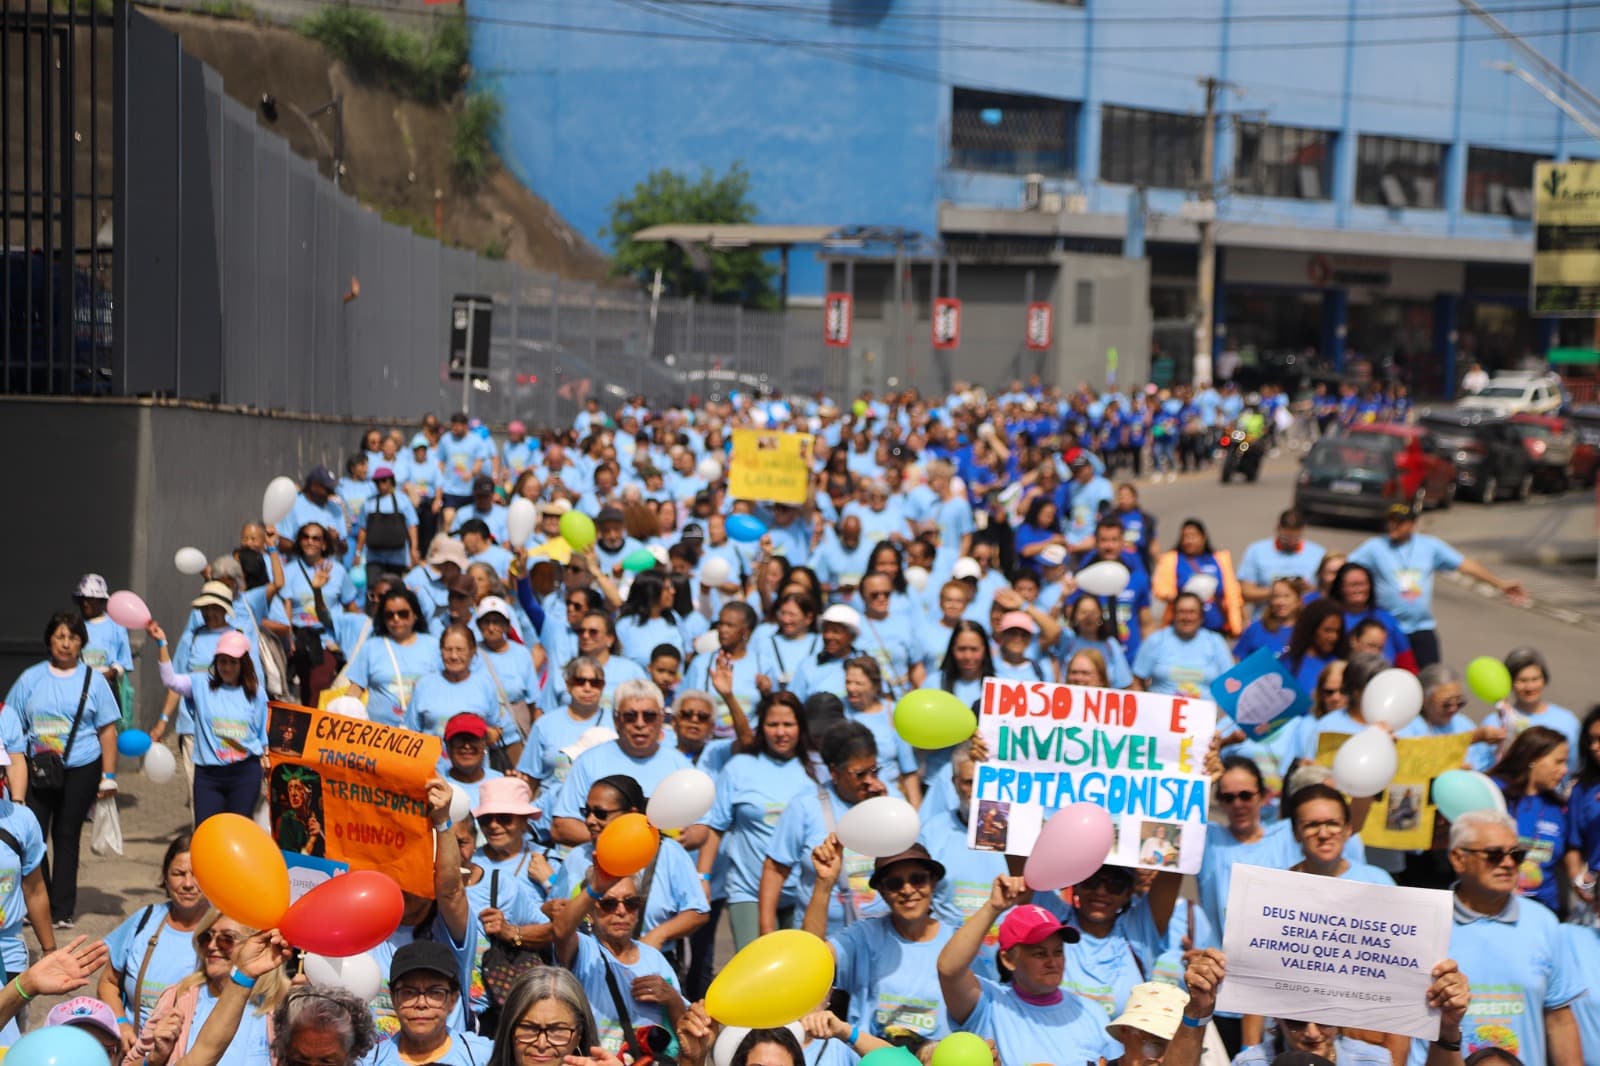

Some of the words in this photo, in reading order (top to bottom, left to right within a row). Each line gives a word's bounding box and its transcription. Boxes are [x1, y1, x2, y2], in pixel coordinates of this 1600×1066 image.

[984, 682, 1072, 720] IDOSO
[316, 716, 423, 758] EXPERIÊNCIA
[997, 725, 1164, 771] INVISIVEL
[319, 748, 377, 775] TAMBÉM
[976, 765, 1207, 824] PROTAGONISTA
[347, 822, 405, 850] MUNDO
[1263, 905, 1296, 920] DEUS
[1300, 911, 1347, 928] NUNCA
[1350, 918, 1387, 933] DISSE
[1390, 923, 1417, 937] QUE
[1281, 925, 1318, 940] SERIA
[1322, 928, 1357, 945] FÁCIL
[1361, 936, 1391, 949] MAS
[1249, 937, 1310, 955] AFIRMOU
[1313, 945, 1340, 959] QUE
[1343, 949, 1352, 960] A
[1355, 950, 1419, 969] JORNADA
[1281, 957, 1335, 974] VALERIA
[1338, 964, 1349, 975] A
[1351, 965, 1387, 980] PENA
[1274, 981, 1310, 994] GRUPO
[1313, 987, 1392, 1004] REJUVENESCER
